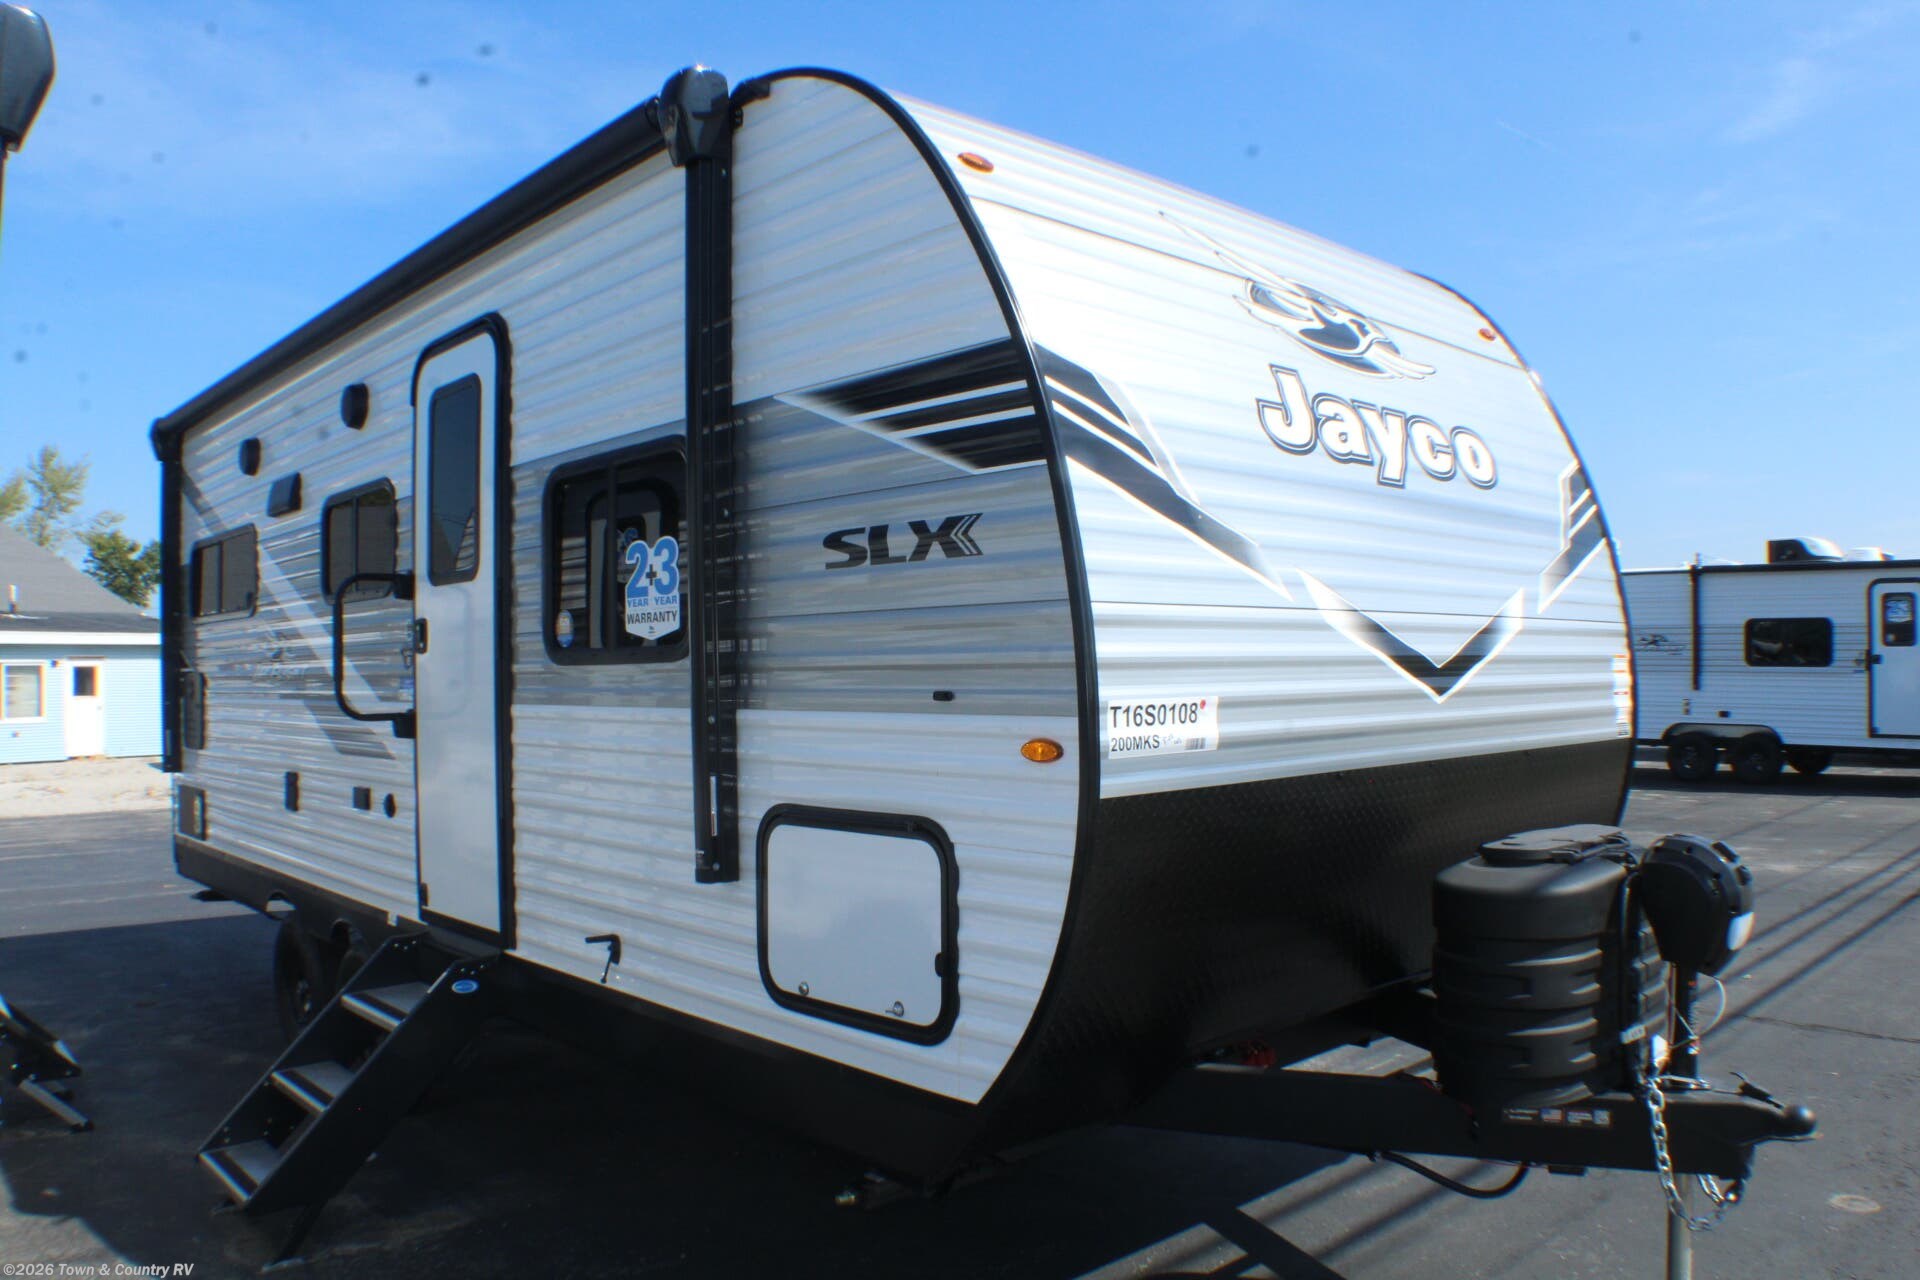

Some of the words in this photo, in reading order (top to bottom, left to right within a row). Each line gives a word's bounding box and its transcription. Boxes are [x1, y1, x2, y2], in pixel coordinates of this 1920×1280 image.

[1255, 363, 1498, 489] Jayco
[823, 513, 983, 569] SLX
[628, 598, 649, 608] YEAR
[655, 595, 677, 605] YEAR
[627, 610, 677, 624] WARRANTY
[1110, 702, 1198, 728] T16S0108
[1111, 734, 1160, 752] 200MKS
